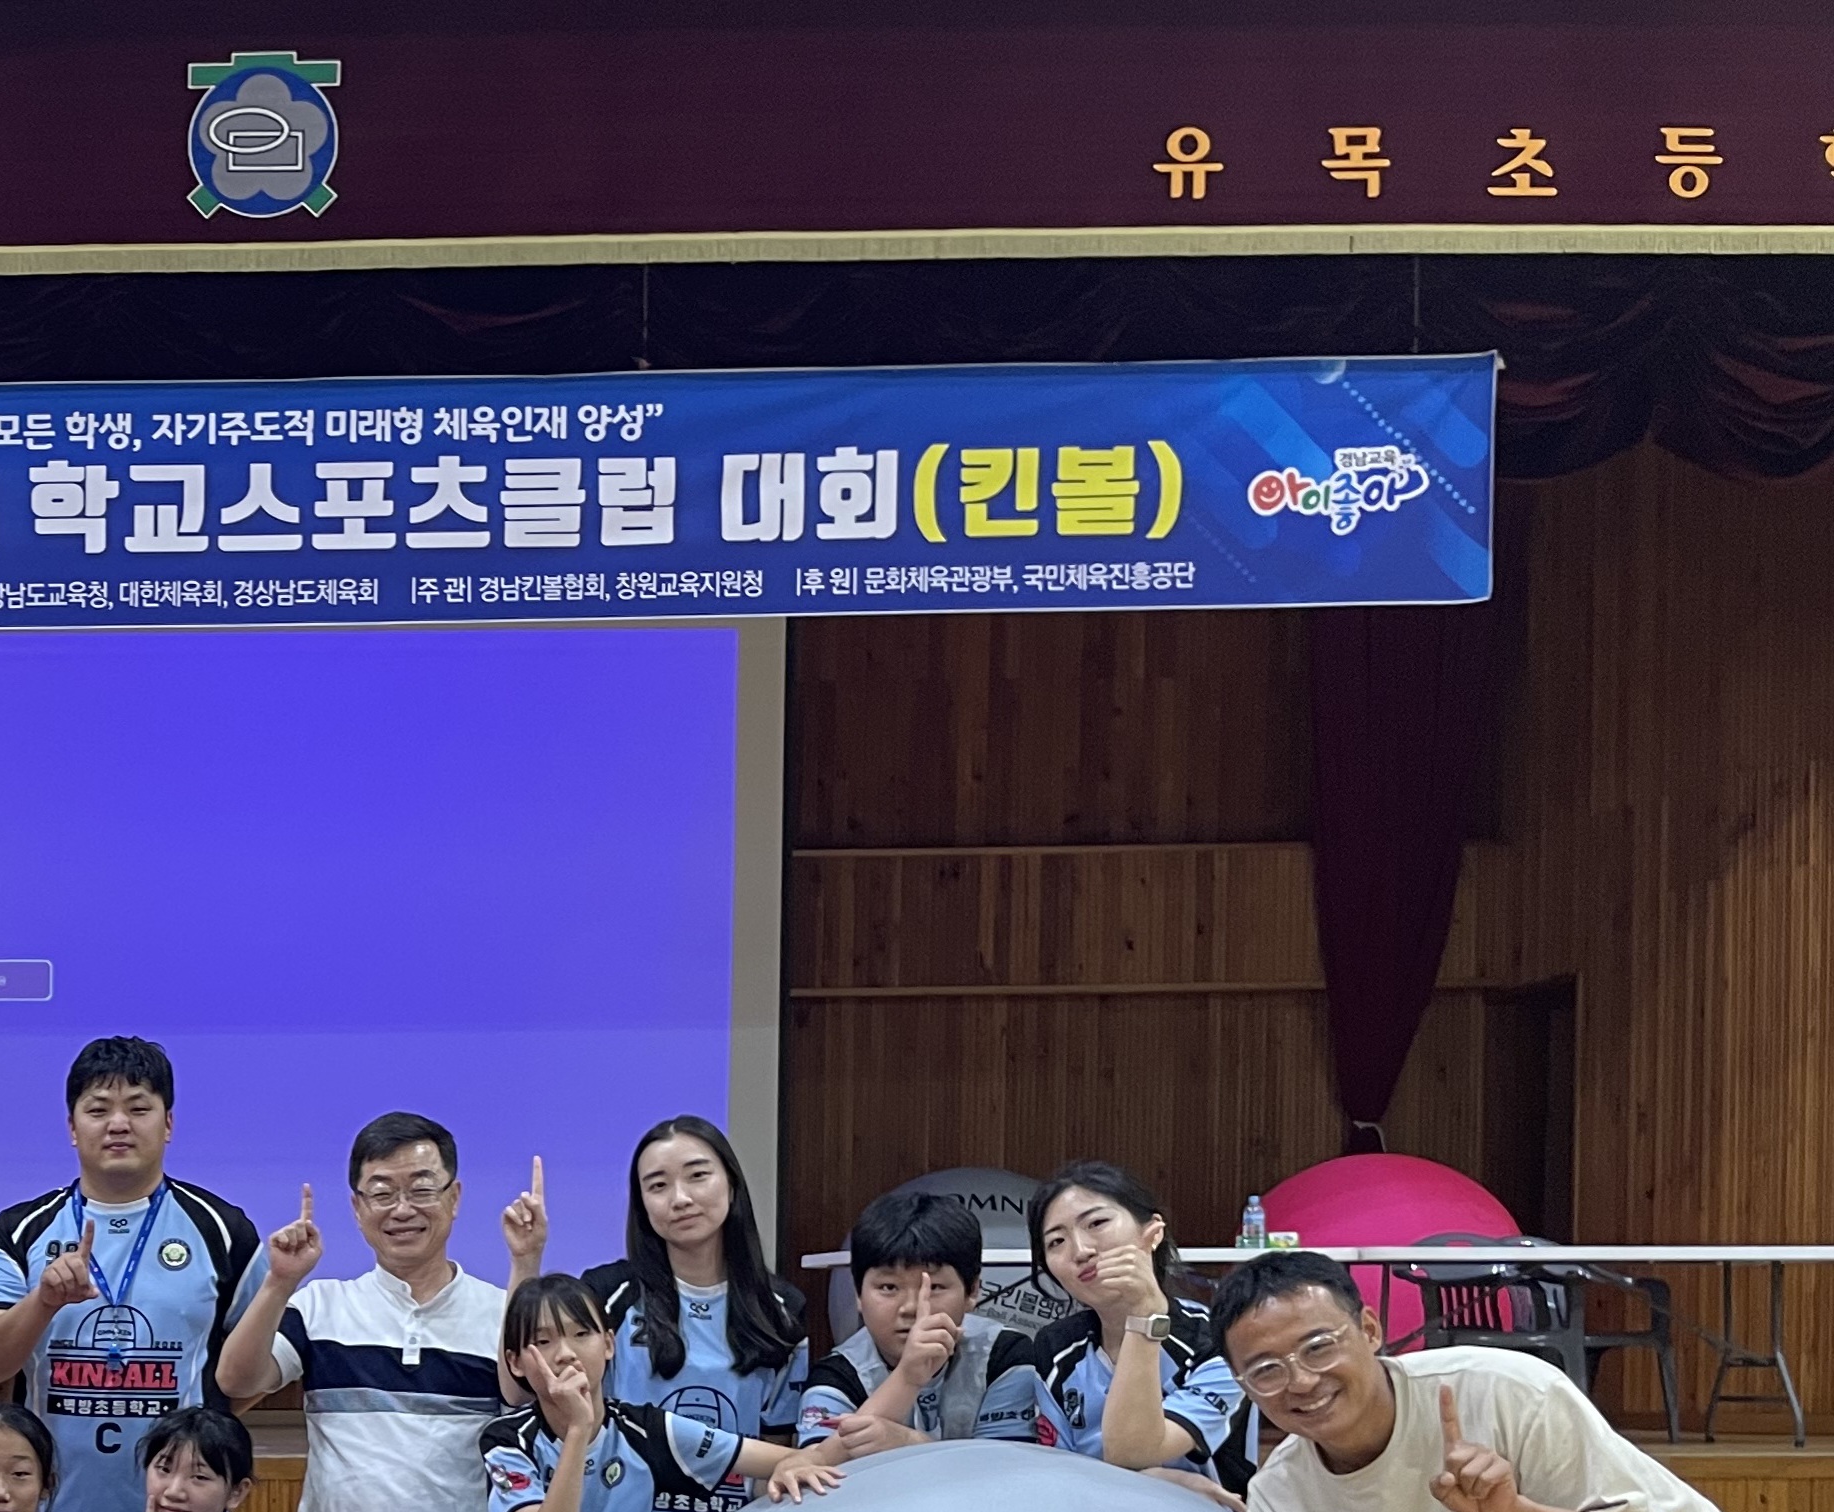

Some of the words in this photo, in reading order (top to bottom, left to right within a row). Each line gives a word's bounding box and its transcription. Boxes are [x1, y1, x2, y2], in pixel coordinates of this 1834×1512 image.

[65, 411, 142, 452] 학생,
[151, 409, 315, 447] 자기주도적
[326, 406, 424, 445] 미래형
[433, 405, 568, 443] 체육인재
[1338, 449, 1398, 468] 경남교육
[28, 454, 677, 554] 학교스포츠클럽
[1253, 471, 1425, 530] 아이좋아
[615, 570, 764, 600] 창원교육지원청
[1022, 561, 1196, 591] 국민체육진흥공단
[233, 577, 379, 607] 경상남도체육회
[51, 1360, 178, 1390] KINBALL
[95, 1421, 123, 1454] C
